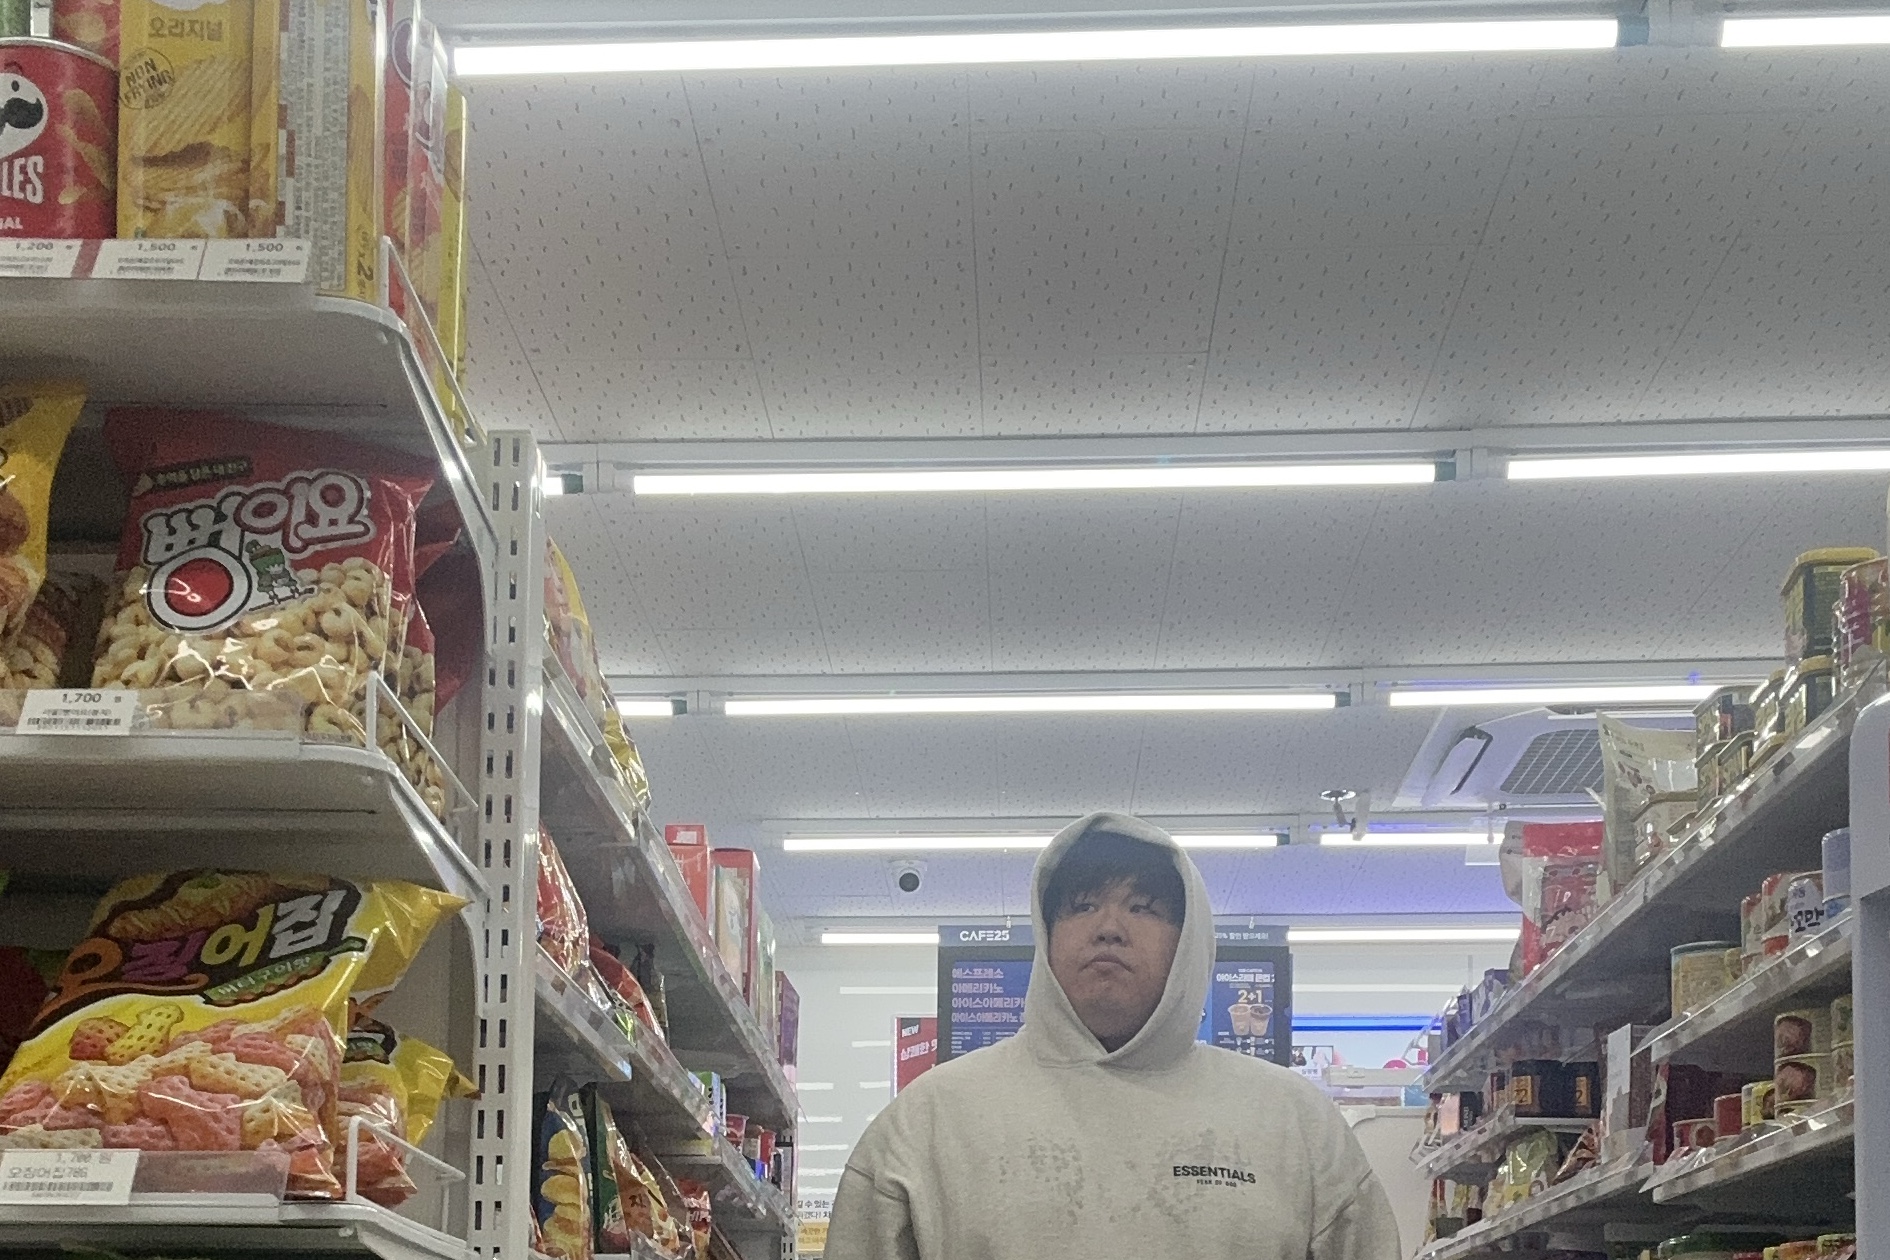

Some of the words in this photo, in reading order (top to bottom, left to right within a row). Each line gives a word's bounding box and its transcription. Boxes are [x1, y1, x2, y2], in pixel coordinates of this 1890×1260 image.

[143, 472, 373, 631] 뻥이요
[62, 692, 102, 704] 1,700
[960, 930, 1010, 941] CAFE25
[28, 889, 347, 1033] 오징어집
[951, 968, 1004, 979] 에스프레소
[951, 983, 1004, 994] 아메리카노
[951, 997, 1026, 1008] 아이스아메리카
[1237, 989, 1263, 1004] 2+1
[901, 1024, 919, 1037] NEW
[1173, 1165, 1256, 1184] ESSENTIALS
